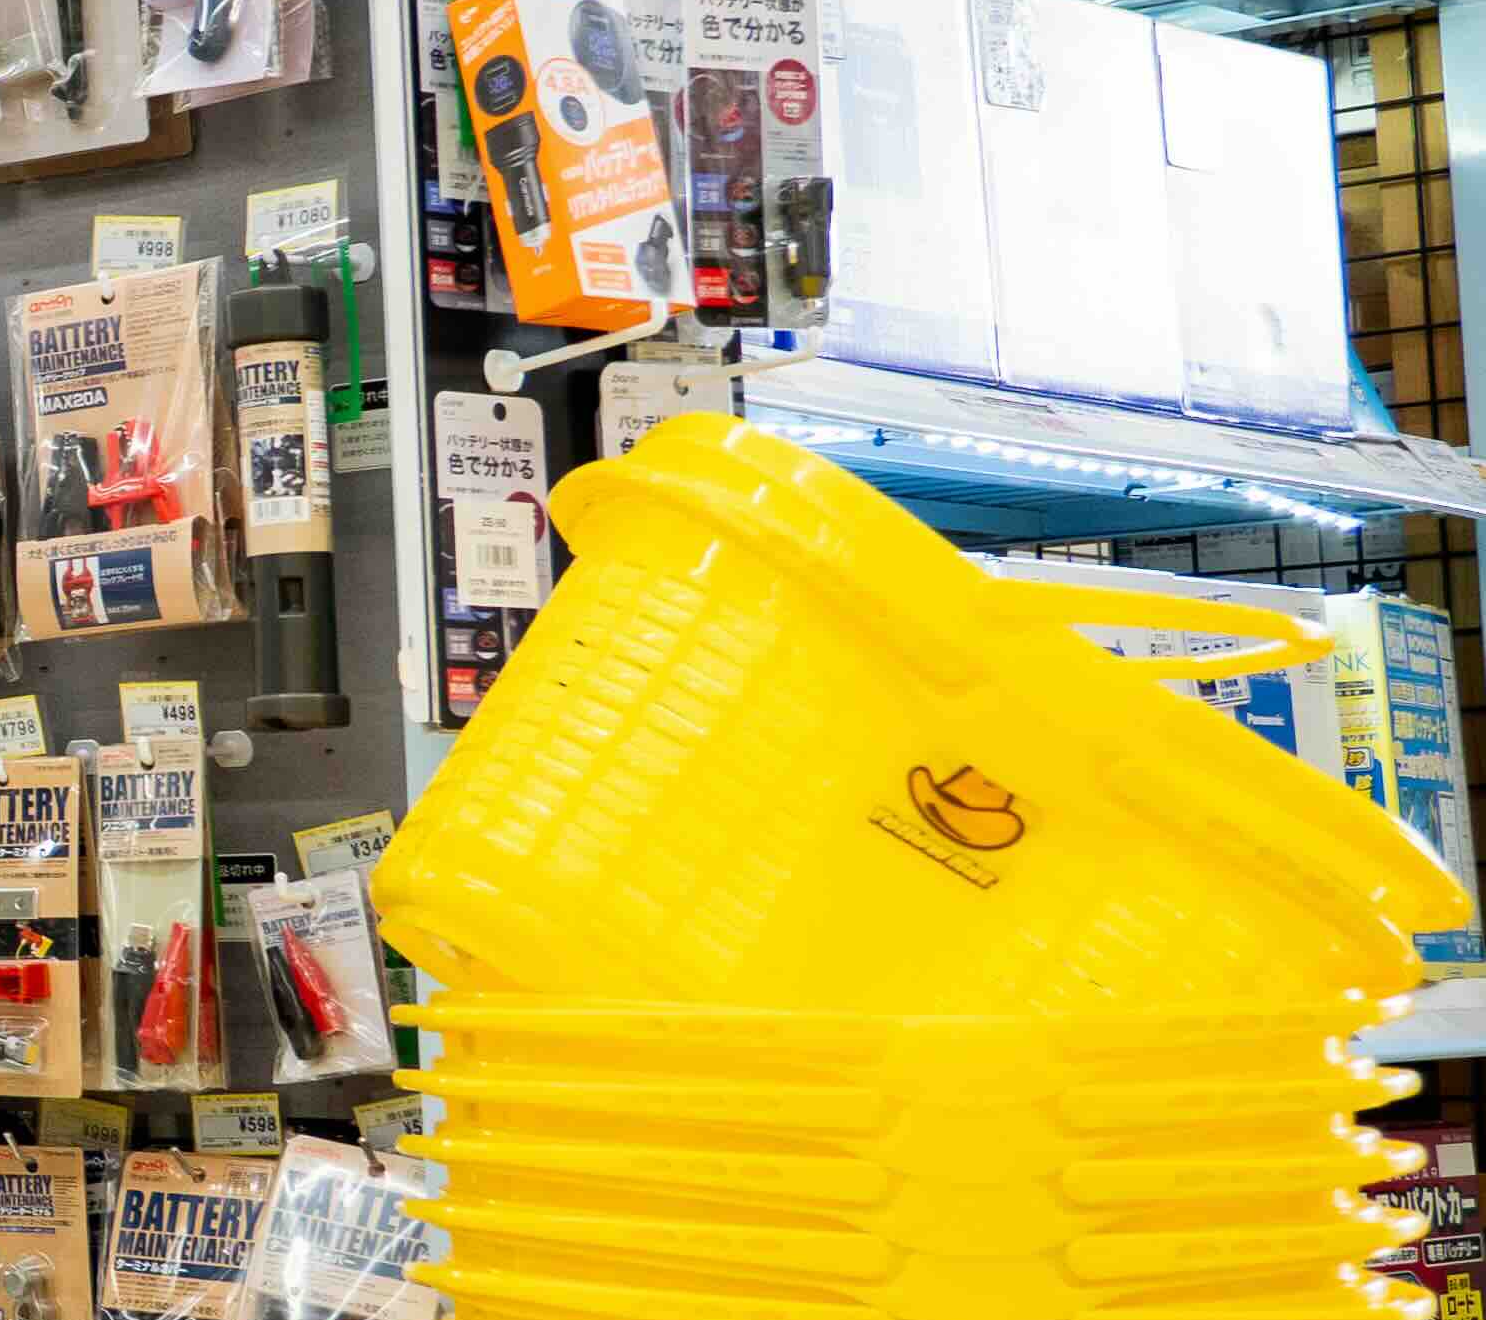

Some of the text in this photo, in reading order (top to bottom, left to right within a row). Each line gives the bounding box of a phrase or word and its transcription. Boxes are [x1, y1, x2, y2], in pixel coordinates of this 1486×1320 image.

[701, 17, 807, 47] 色で分かる
[137, 238, 175, 259] ¥998
[29, 294, 74, 314] amon
[29, 312, 123, 355] BATTERY
[29, 342, 127, 374] MAINTENANCE
[39, 390, 106, 413] MAX20A
[160, 702, 197, 722] ¥498
[0, 717, 38, 738] ¥798
[238, 1114, 278, 1135] ¥598
